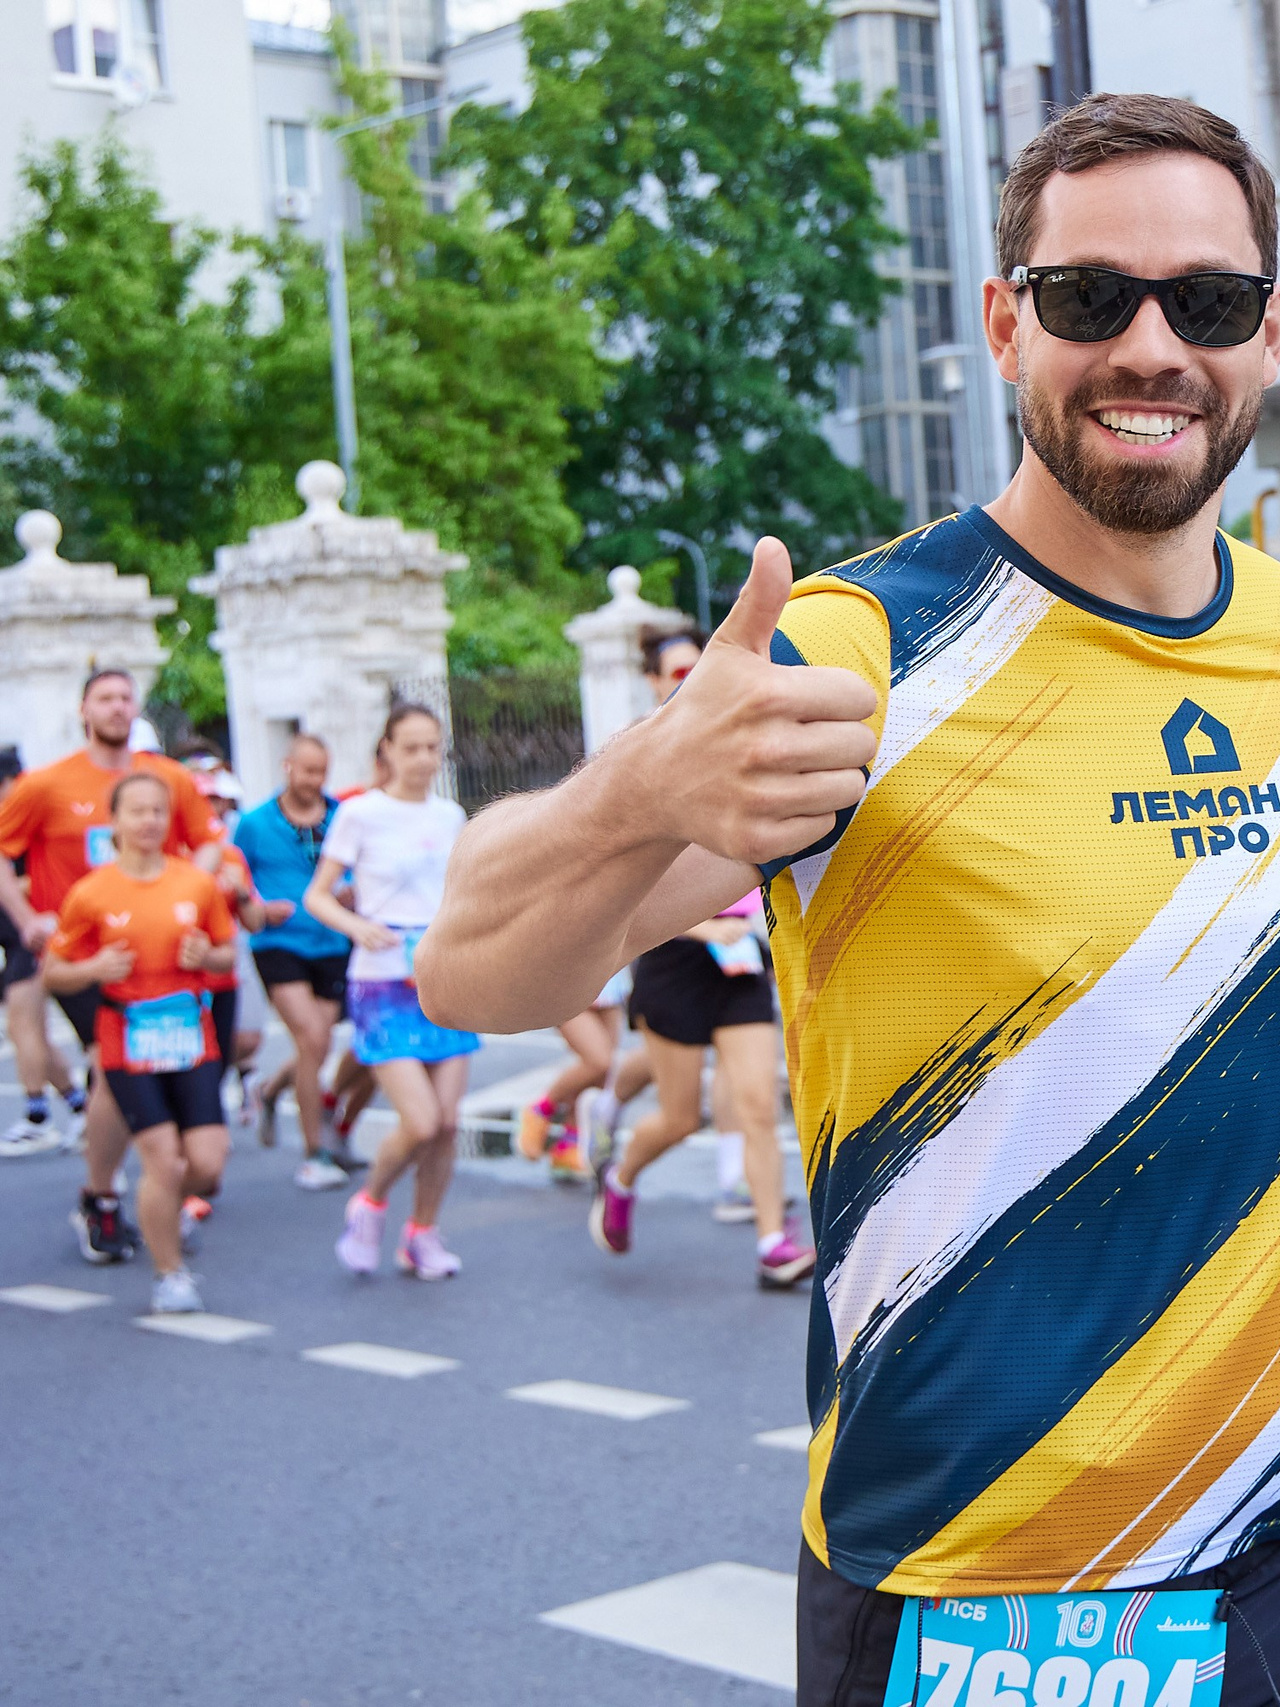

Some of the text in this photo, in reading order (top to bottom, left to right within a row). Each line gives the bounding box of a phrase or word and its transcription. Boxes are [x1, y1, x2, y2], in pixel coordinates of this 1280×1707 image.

[1171, 822, 1270, 859] ПРО
[943, 1598, 988, 1622] ПСБ
[1055, 1600, 1107, 1648] 10
